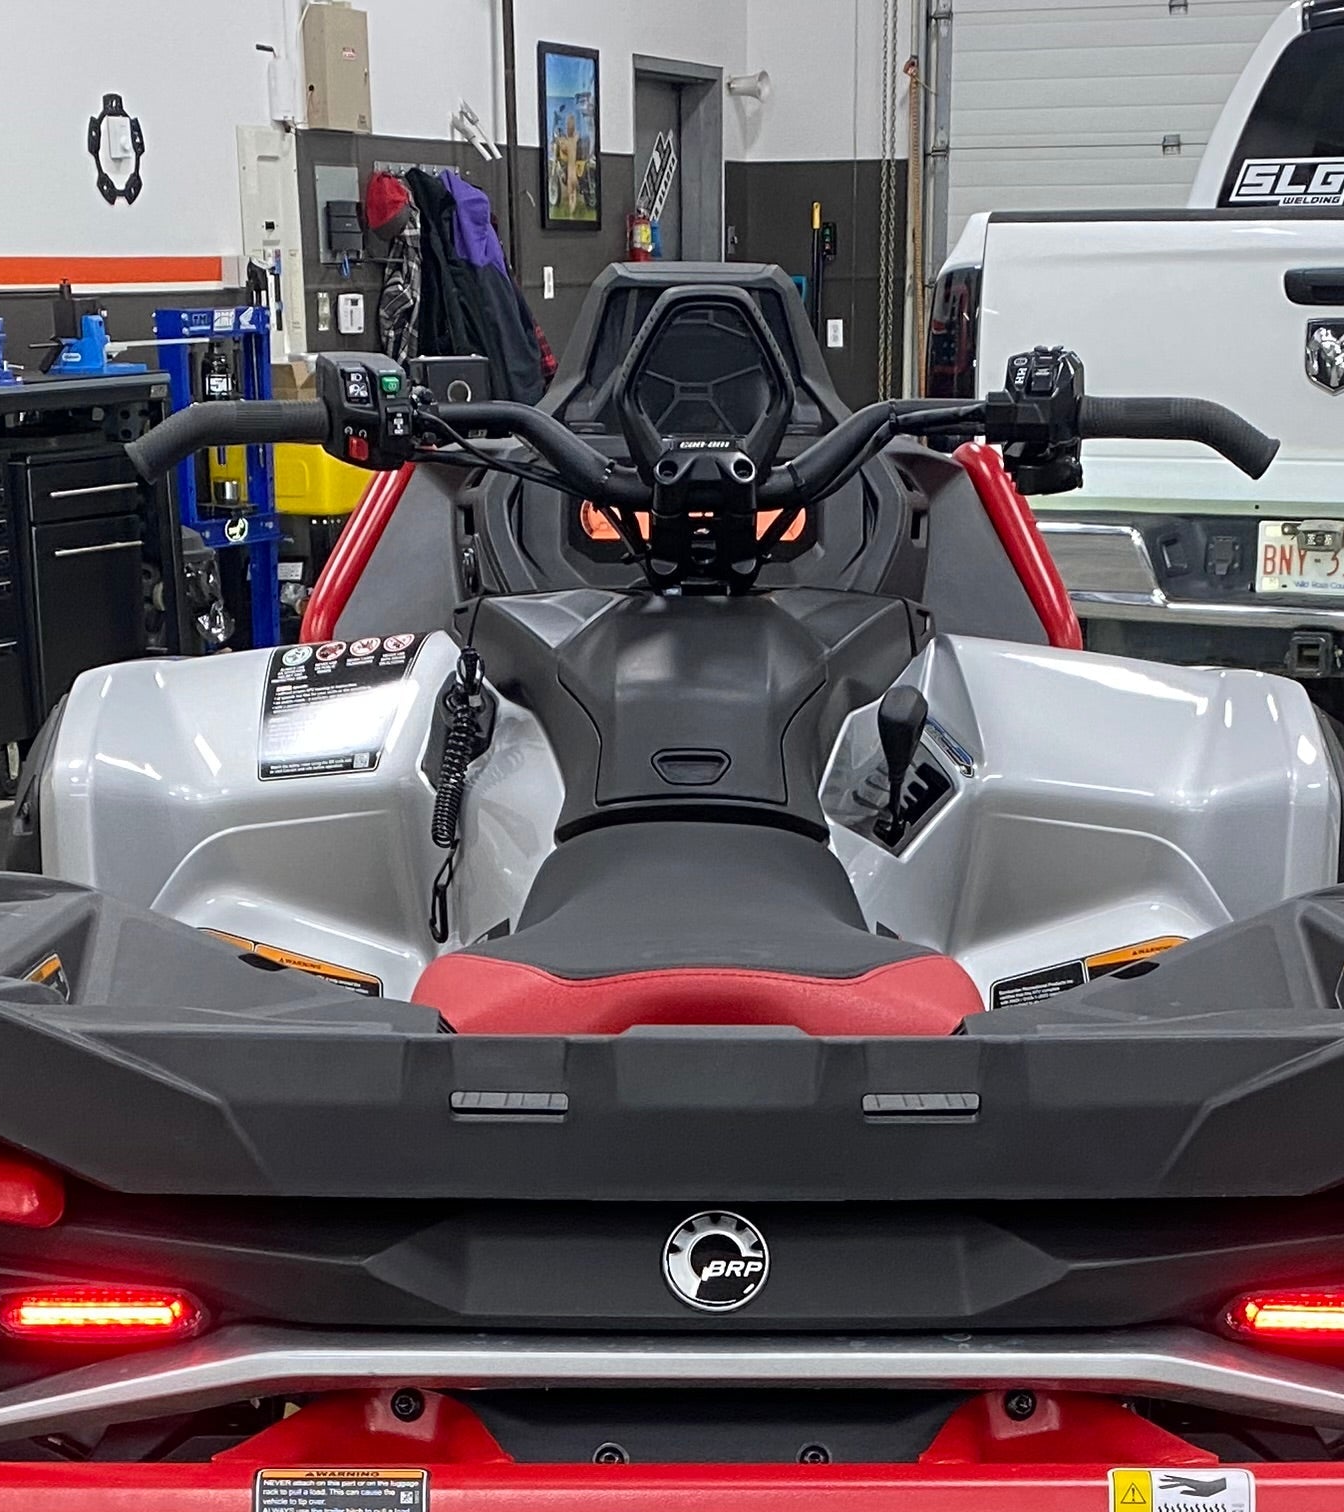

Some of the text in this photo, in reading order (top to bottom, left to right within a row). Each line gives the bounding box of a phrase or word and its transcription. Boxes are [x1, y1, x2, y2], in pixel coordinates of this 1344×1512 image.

[1282, 196, 1342, 204] WELDING
[285, 958, 322, 970] WARNING
[702, 1260, 763, 1281] BRP
[298, 1498, 307, 1506] tip
